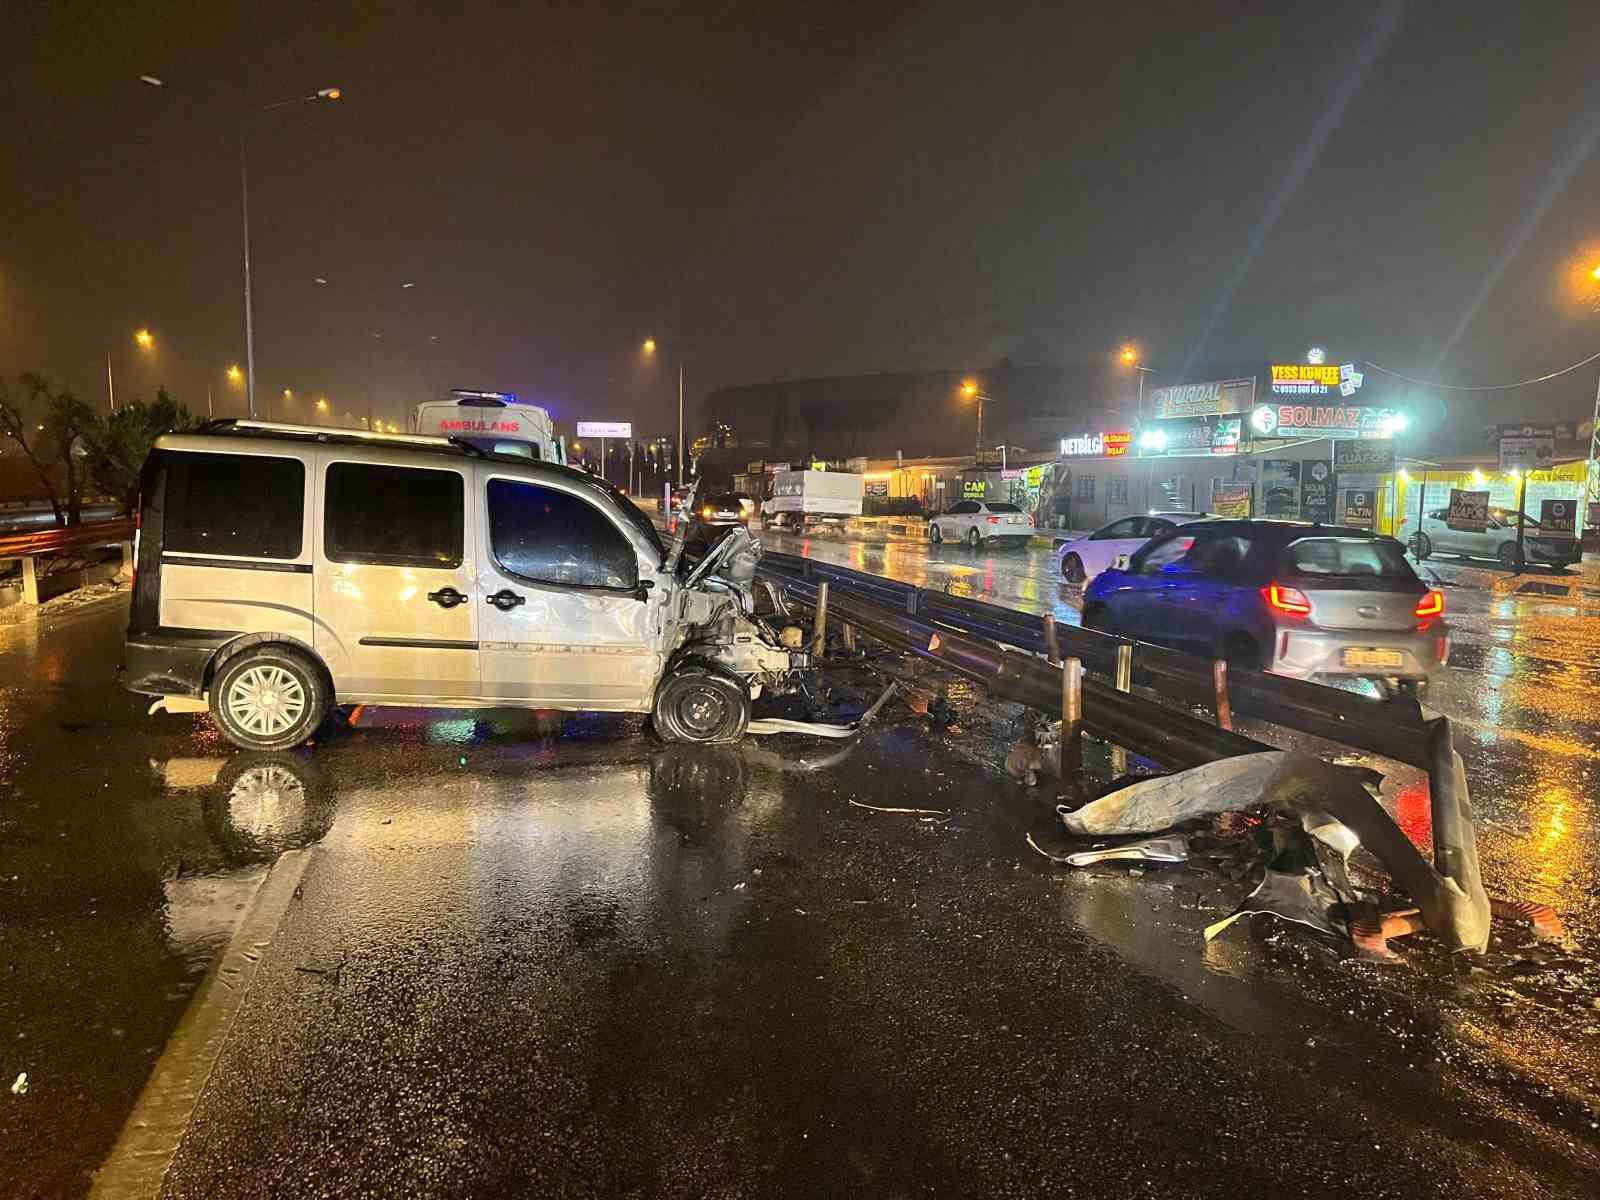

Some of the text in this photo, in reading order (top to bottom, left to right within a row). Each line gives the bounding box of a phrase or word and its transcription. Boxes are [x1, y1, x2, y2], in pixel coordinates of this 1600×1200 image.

[1279, 406, 1361, 427] SOLMAZ
[440, 419, 520, 432] AMBULANS
[964, 481, 986, 492] CAN
